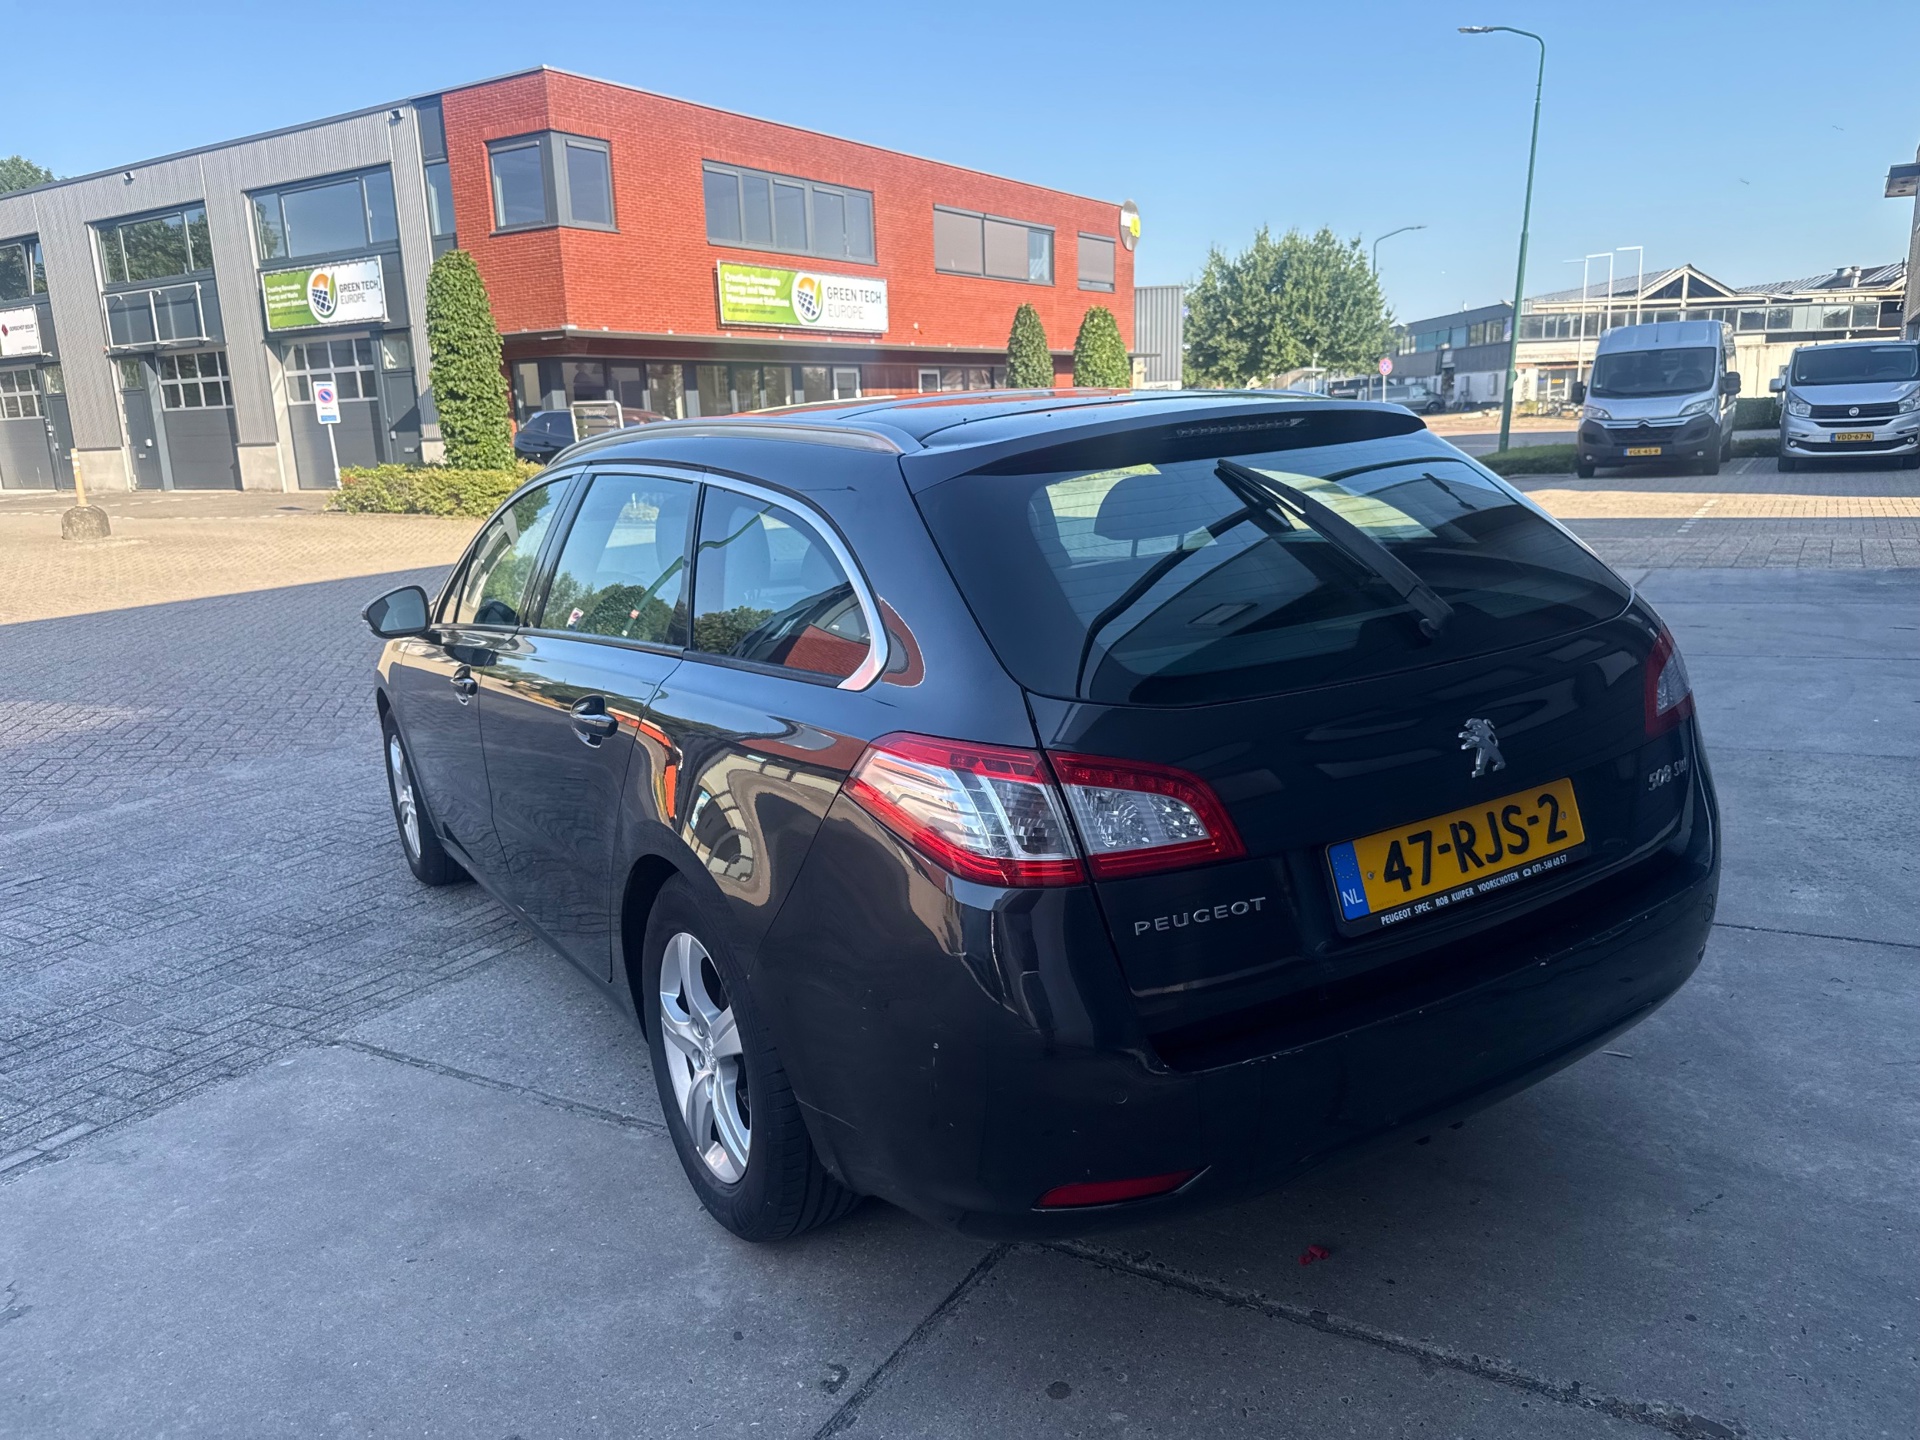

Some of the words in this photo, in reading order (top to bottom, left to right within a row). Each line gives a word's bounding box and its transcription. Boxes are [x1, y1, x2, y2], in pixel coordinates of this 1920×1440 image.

[339, 282, 361, 293] GREEN
[361, 280, 379, 291] TECH
[827, 286, 857, 301] GREEN
[859, 289, 882, 304] TECH
[340, 292, 366, 305] EUROPE
[828, 303, 864, 320] EUROPE
[1648, 764, 1671, 791] 508
[1383, 793, 1568, 892] 47-RJS-2
[1343, 888, 1363, 907] NL
[1381, 907, 1412, 925] PEUGEOT
[1414, 901, 1433, 914] SPEC.
[1435, 895, 1449, 907] ROB
[1450, 887, 1475, 902] KUIPER
[1477, 871, 1519, 892] VOORSCHOTEN
[1134, 897, 1266, 936] PEUGEOT
